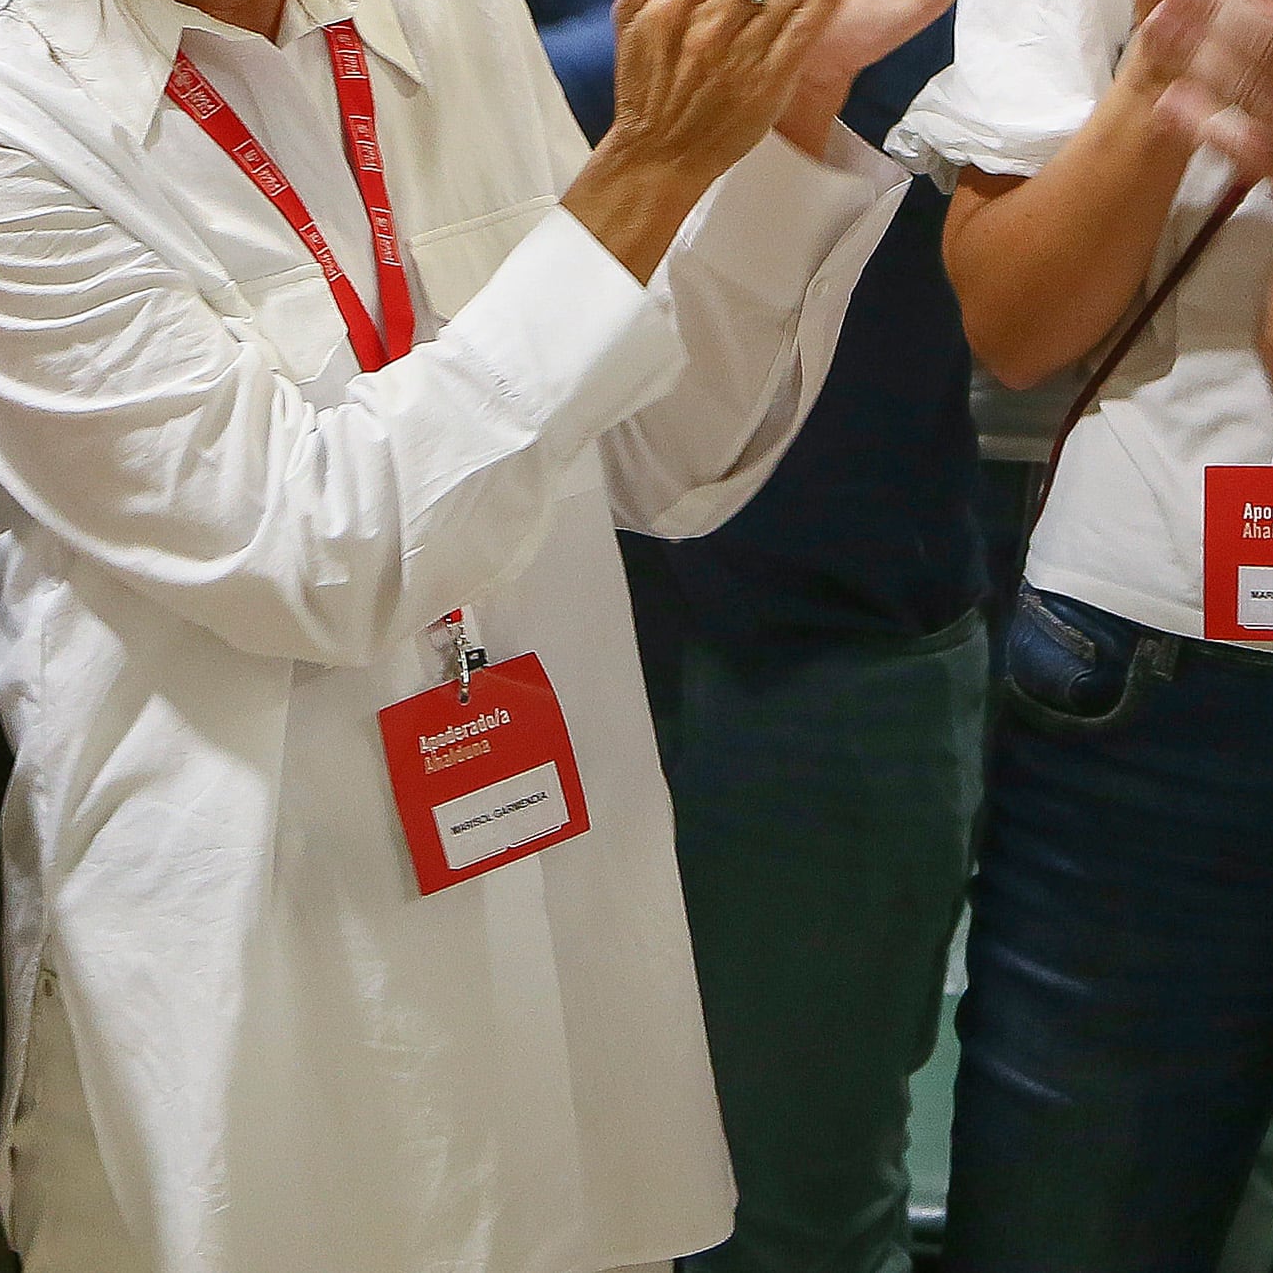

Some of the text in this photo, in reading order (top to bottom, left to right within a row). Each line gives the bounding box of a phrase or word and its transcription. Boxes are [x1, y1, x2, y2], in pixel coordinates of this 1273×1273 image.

[418, 707, 511, 756] Apoderado/a
[424, 738, 491, 775] Ahalduna
[450, 791, 549, 836] MARISOL GARMENDIA
